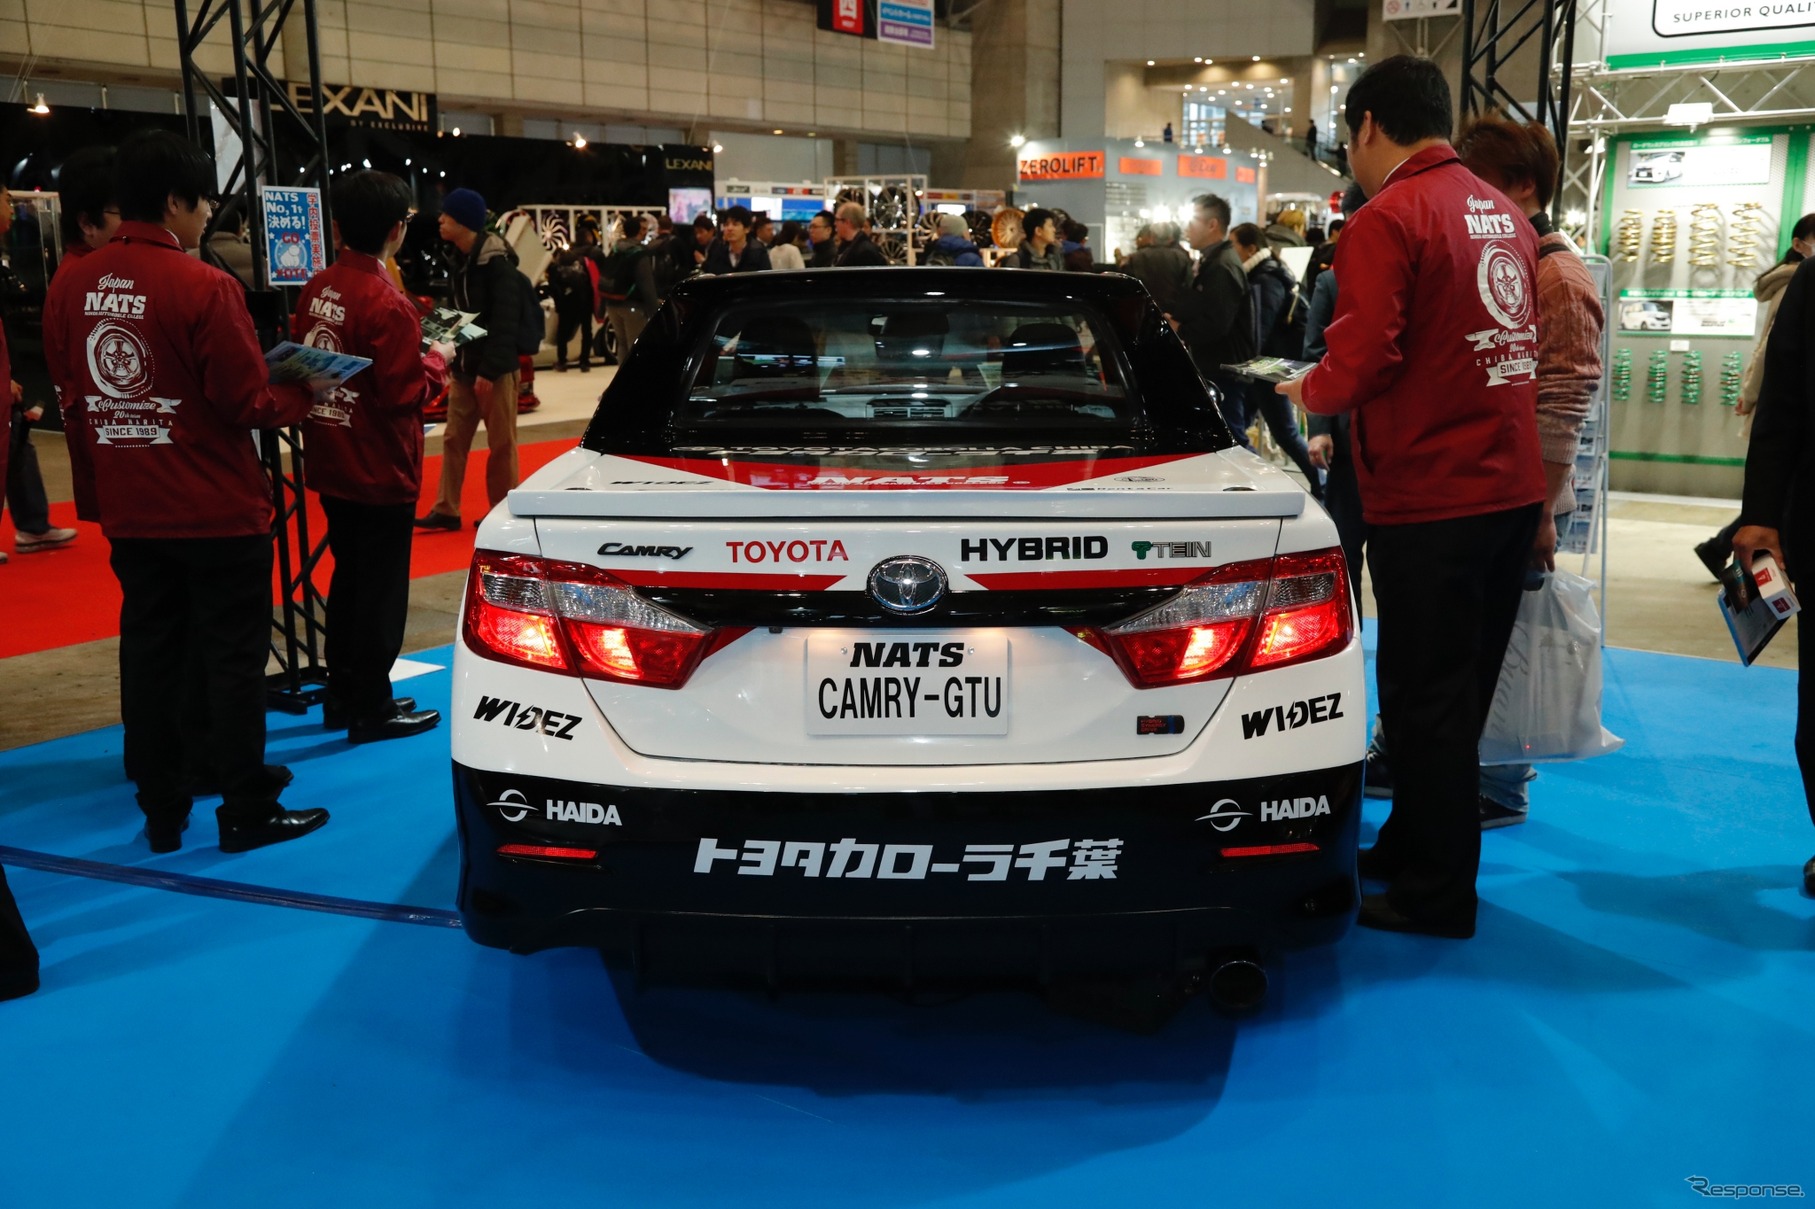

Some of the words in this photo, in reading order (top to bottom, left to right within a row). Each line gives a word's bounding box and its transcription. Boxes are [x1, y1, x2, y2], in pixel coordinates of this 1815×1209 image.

[1673, 7, 1752, 23] SUPERIOR
[1759, 2, 1815, 17] QUALI
[666, 158, 712, 171] LEXANI
[1020, 156, 1097, 175] ZEROLIFT
[265, 192, 299, 202] NATS
[1467, 195, 1495, 214] Japan
[1464, 213, 1515, 234] NATS
[282, 232, 300, 244] GO
[97, 272, 134, 293] Japan
[84, 292, 146, 315] NATS
[309, 297, 346, 322] NATS
[1500, 361, 1521, 374] SINCE
[105, 427, 133, 436] SINCE
[135, 427, 157, 436] 1989
[726, 540, 849, 563] TOYOTA
[961, 536, 1108, 562] HYBRID
[1152, 541, 1212, 559] TEIN
[850, 643, 965, 667] NATS
[818, 676, 1001, 719] CAMRY-GTU
[473, 695, 583, 741] WIDEZ
[1241, 692, 1344, 740] WIDEZ
[546, 799, 622, 826] HAIDA
[1260, 795, 1331, 822] HAIDA
[693, 837, 1125, 882] トヨタカローラ千葉
